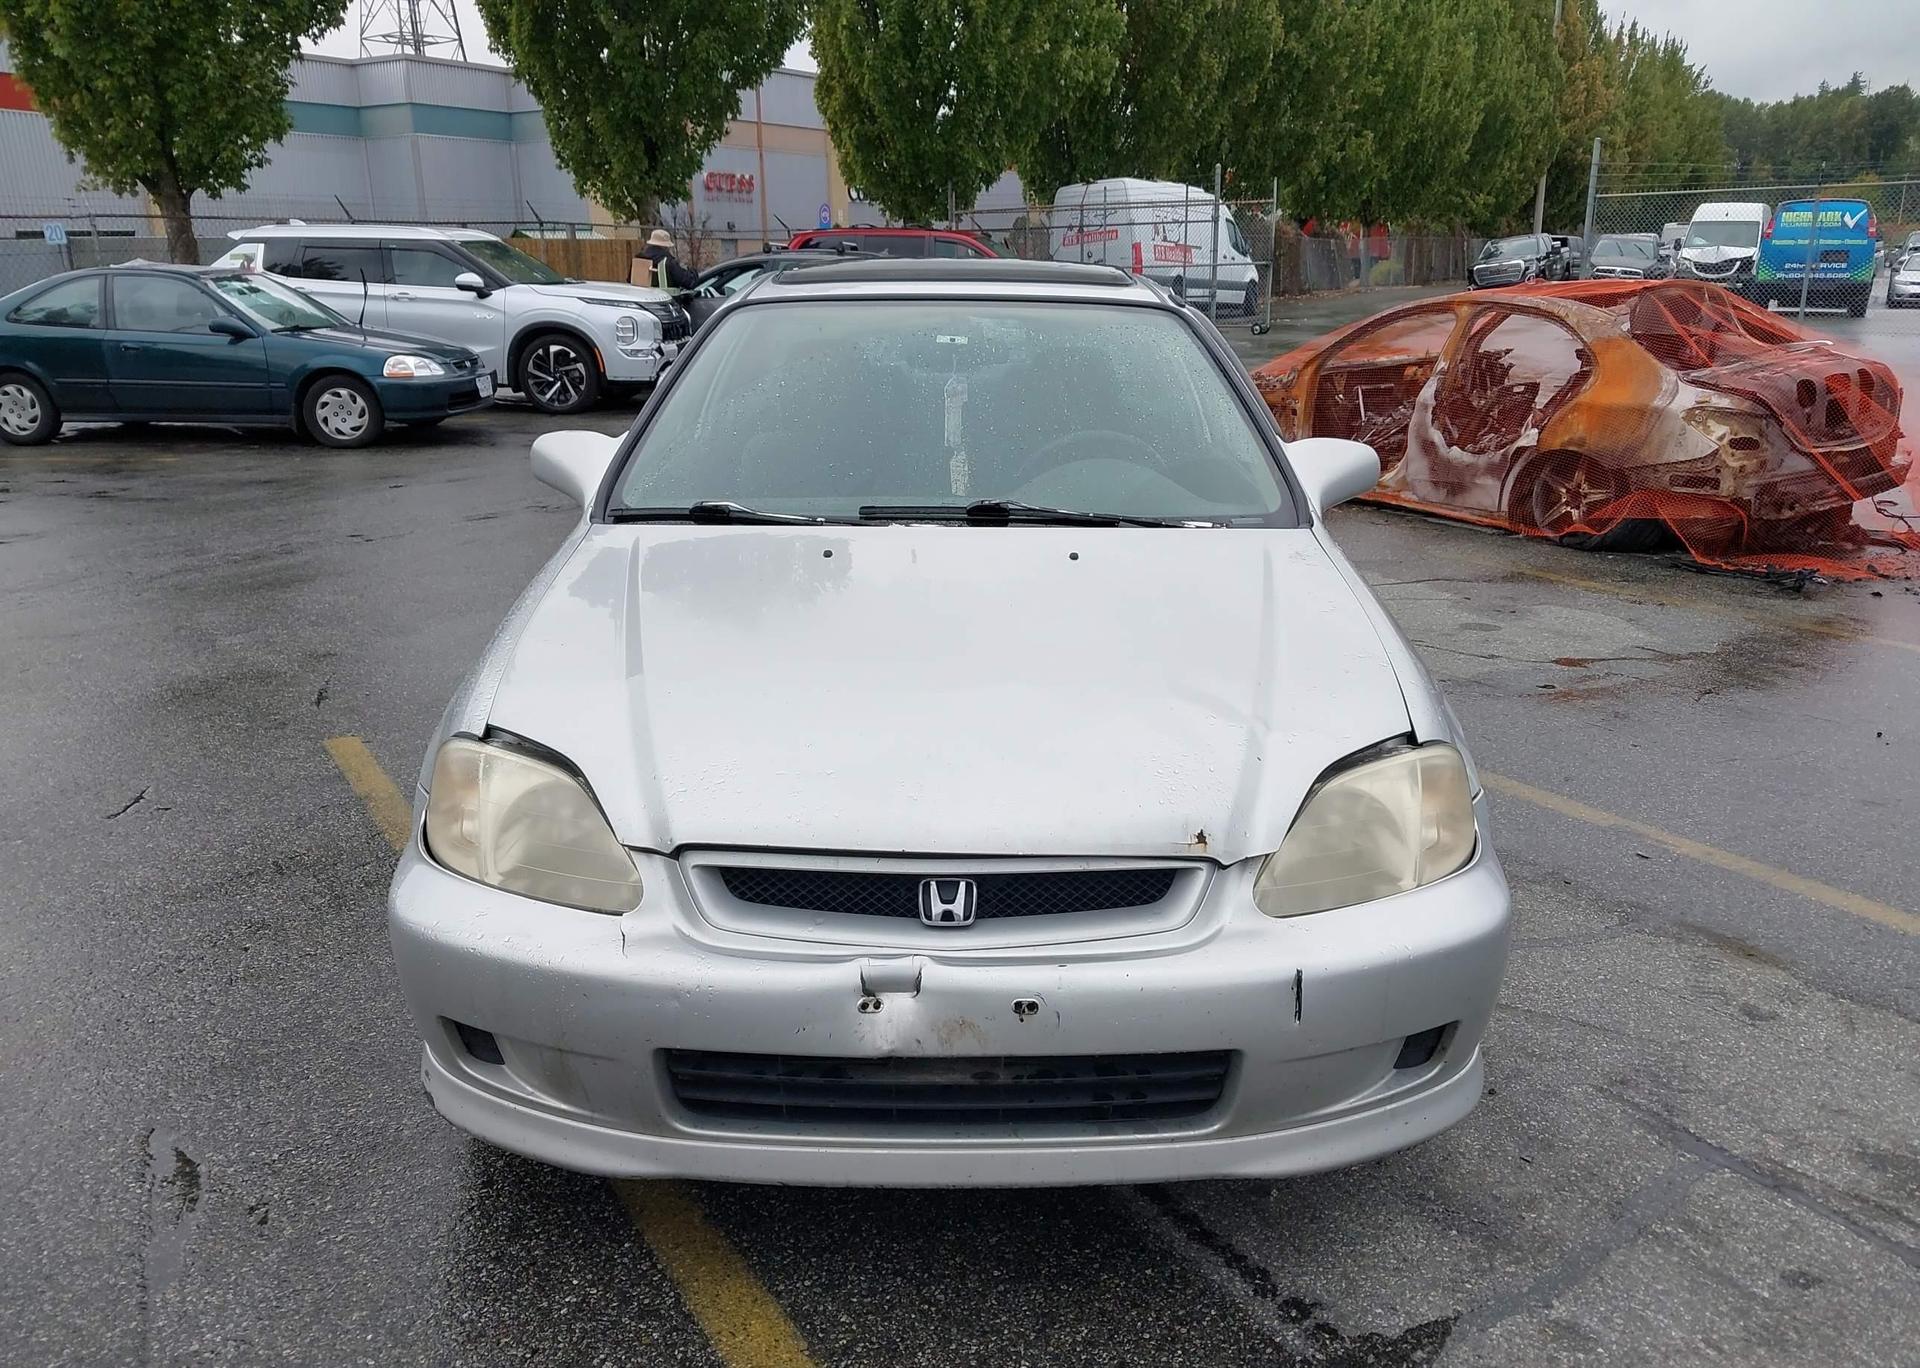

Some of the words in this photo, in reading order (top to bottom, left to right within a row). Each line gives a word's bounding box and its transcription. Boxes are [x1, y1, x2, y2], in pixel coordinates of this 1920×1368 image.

[705, 171, 755, 193] GUESS
[1782, 211, 1842, 222] HIGHARK
[46, 224, 63, 242] 20
